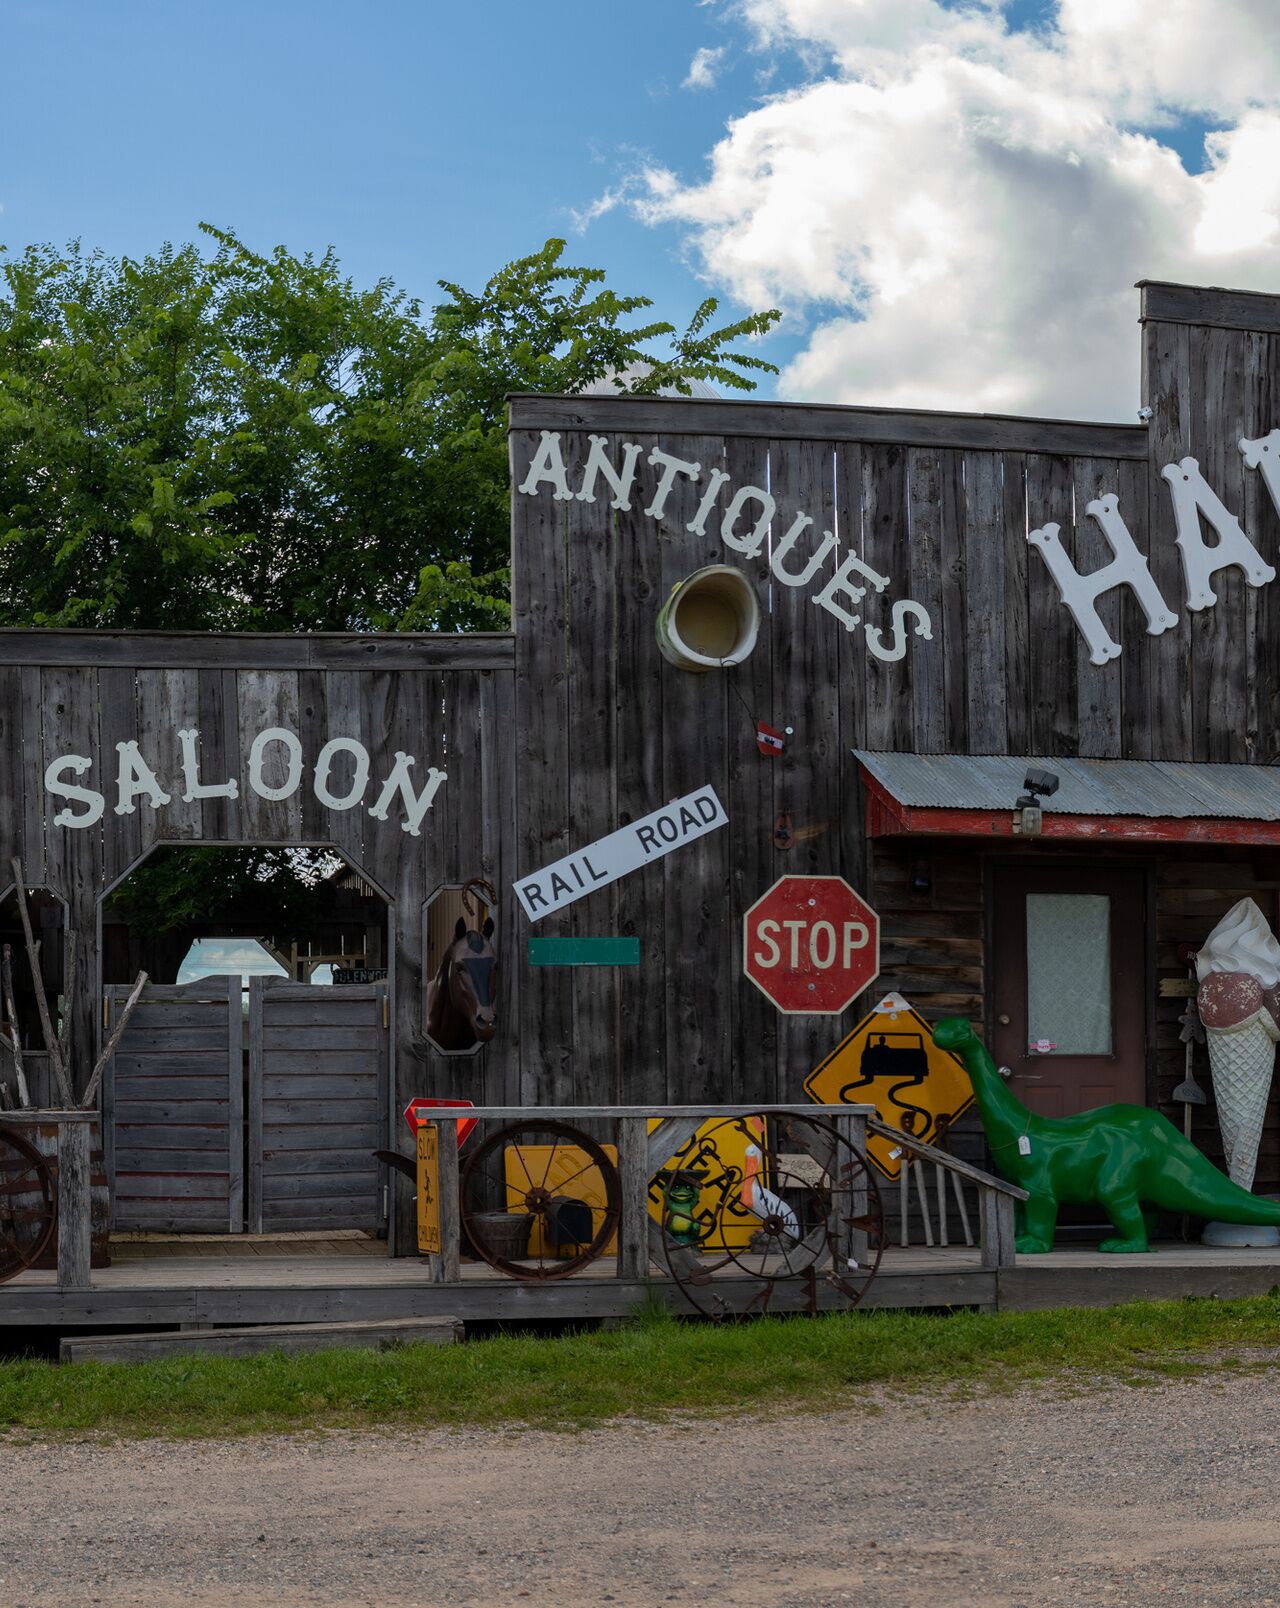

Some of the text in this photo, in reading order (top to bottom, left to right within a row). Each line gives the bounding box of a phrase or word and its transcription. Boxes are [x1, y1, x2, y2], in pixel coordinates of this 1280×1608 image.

[518, 430, 933, 663] ANTIQUES
[44, 727, 448, 836] SALOON
[521, 796, 718, 912] RAIL ROAD
[754, 919, 869, 969] STOP
